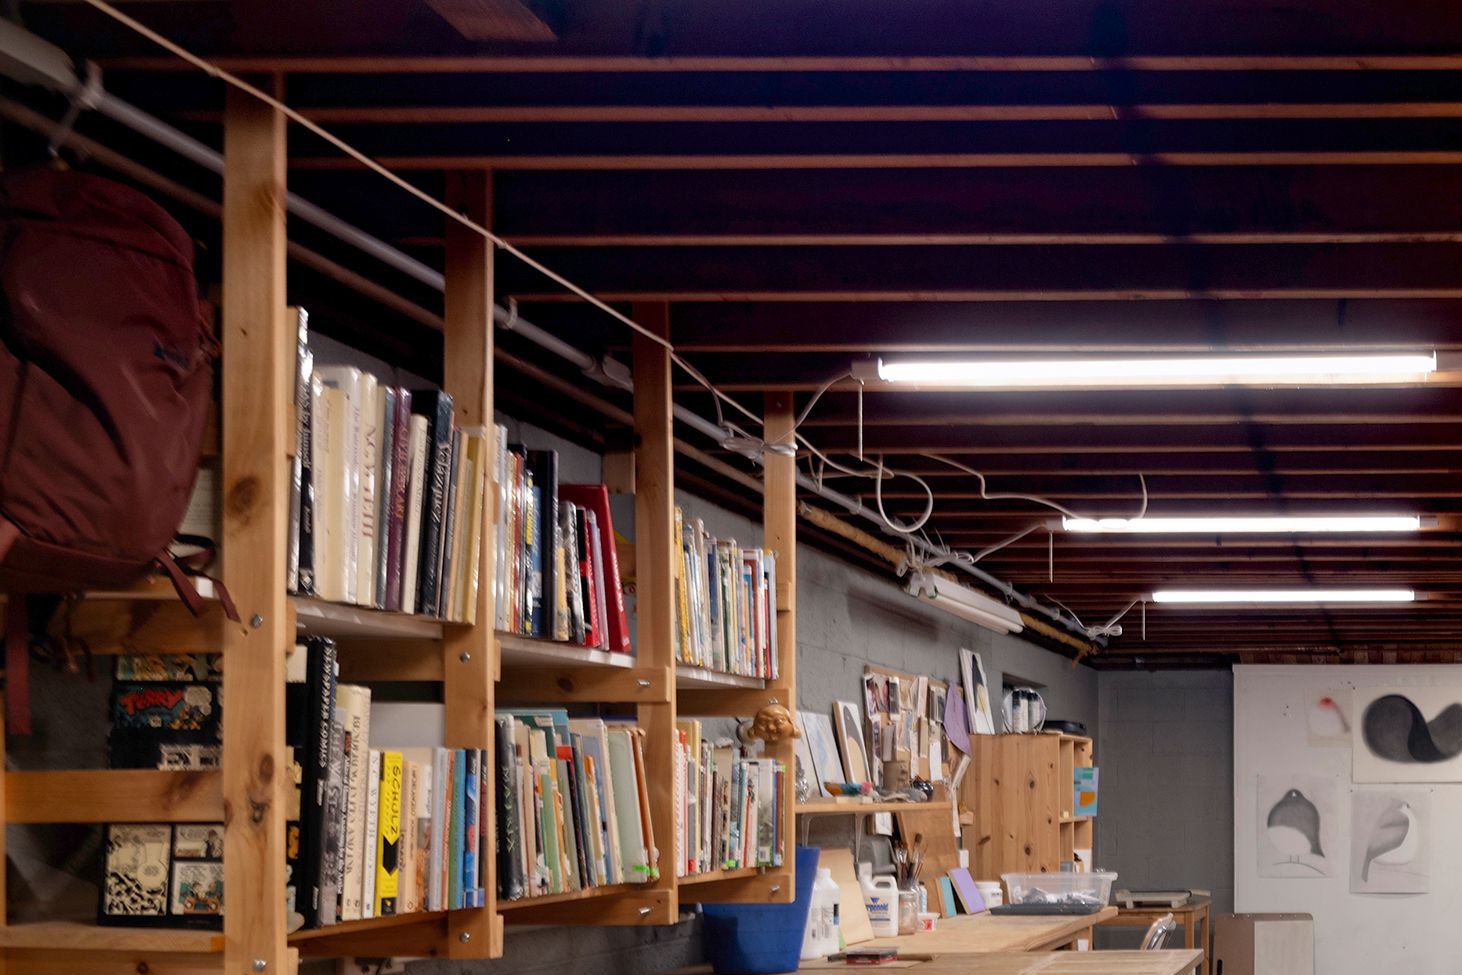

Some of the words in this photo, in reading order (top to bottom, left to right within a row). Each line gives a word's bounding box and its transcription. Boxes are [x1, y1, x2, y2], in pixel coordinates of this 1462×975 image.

[321, 645, 334, 720] NEWSPAPER
[319, 721, 329, 768] COMICS
[391, 765, 402, 835] SCHULZ
[502, 767, 515, 853] MATRIX
